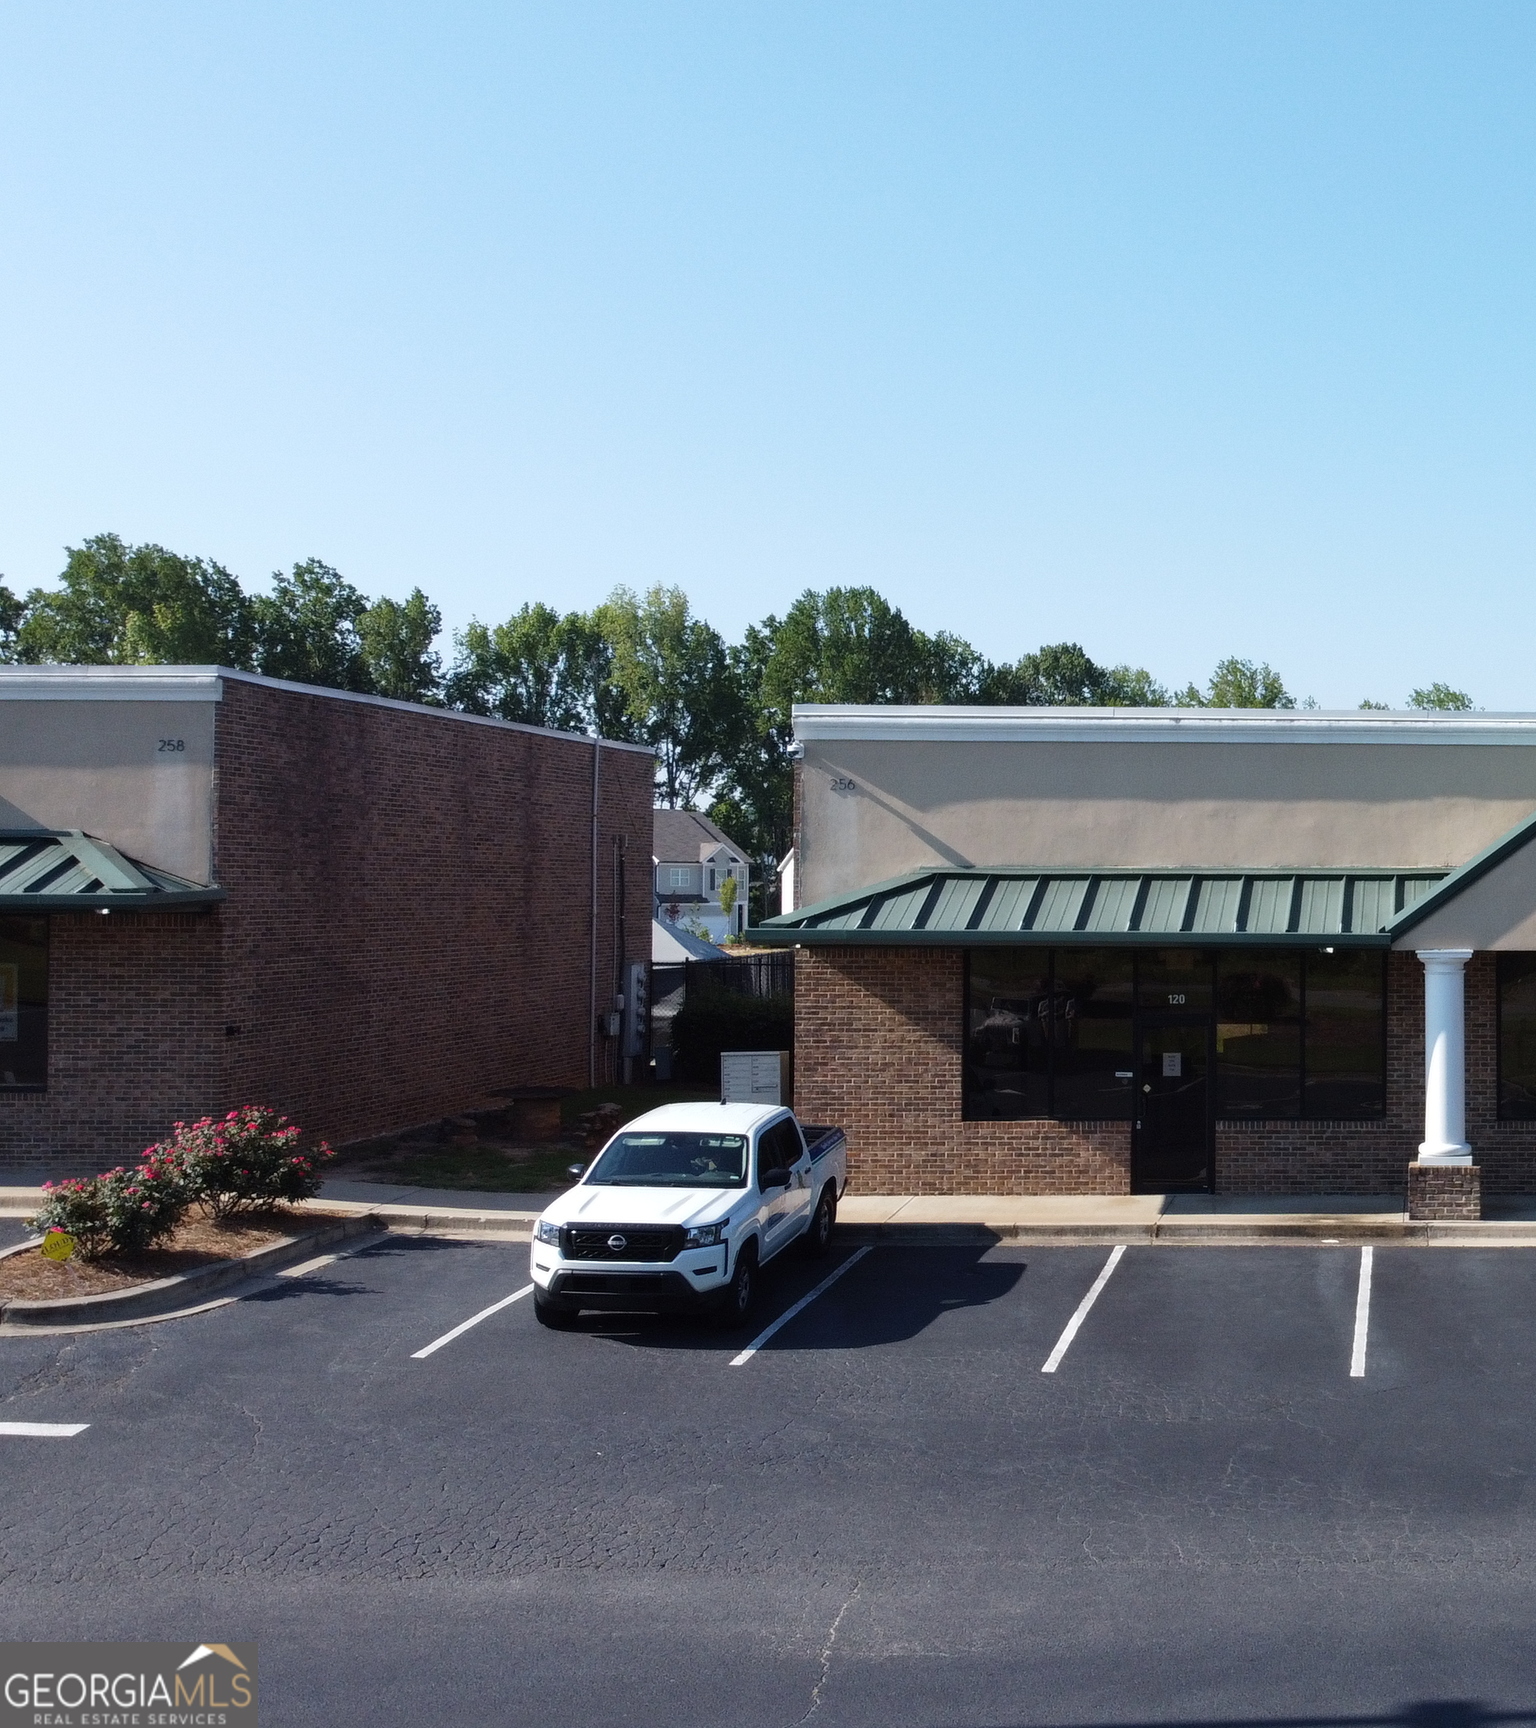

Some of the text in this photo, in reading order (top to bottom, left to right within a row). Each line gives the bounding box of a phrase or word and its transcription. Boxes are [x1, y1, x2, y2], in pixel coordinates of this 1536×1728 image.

[158, 740, 185, 751] 258
[830, 779, 856, 791] 256
[1168, 994, 1186, 1005] 120
